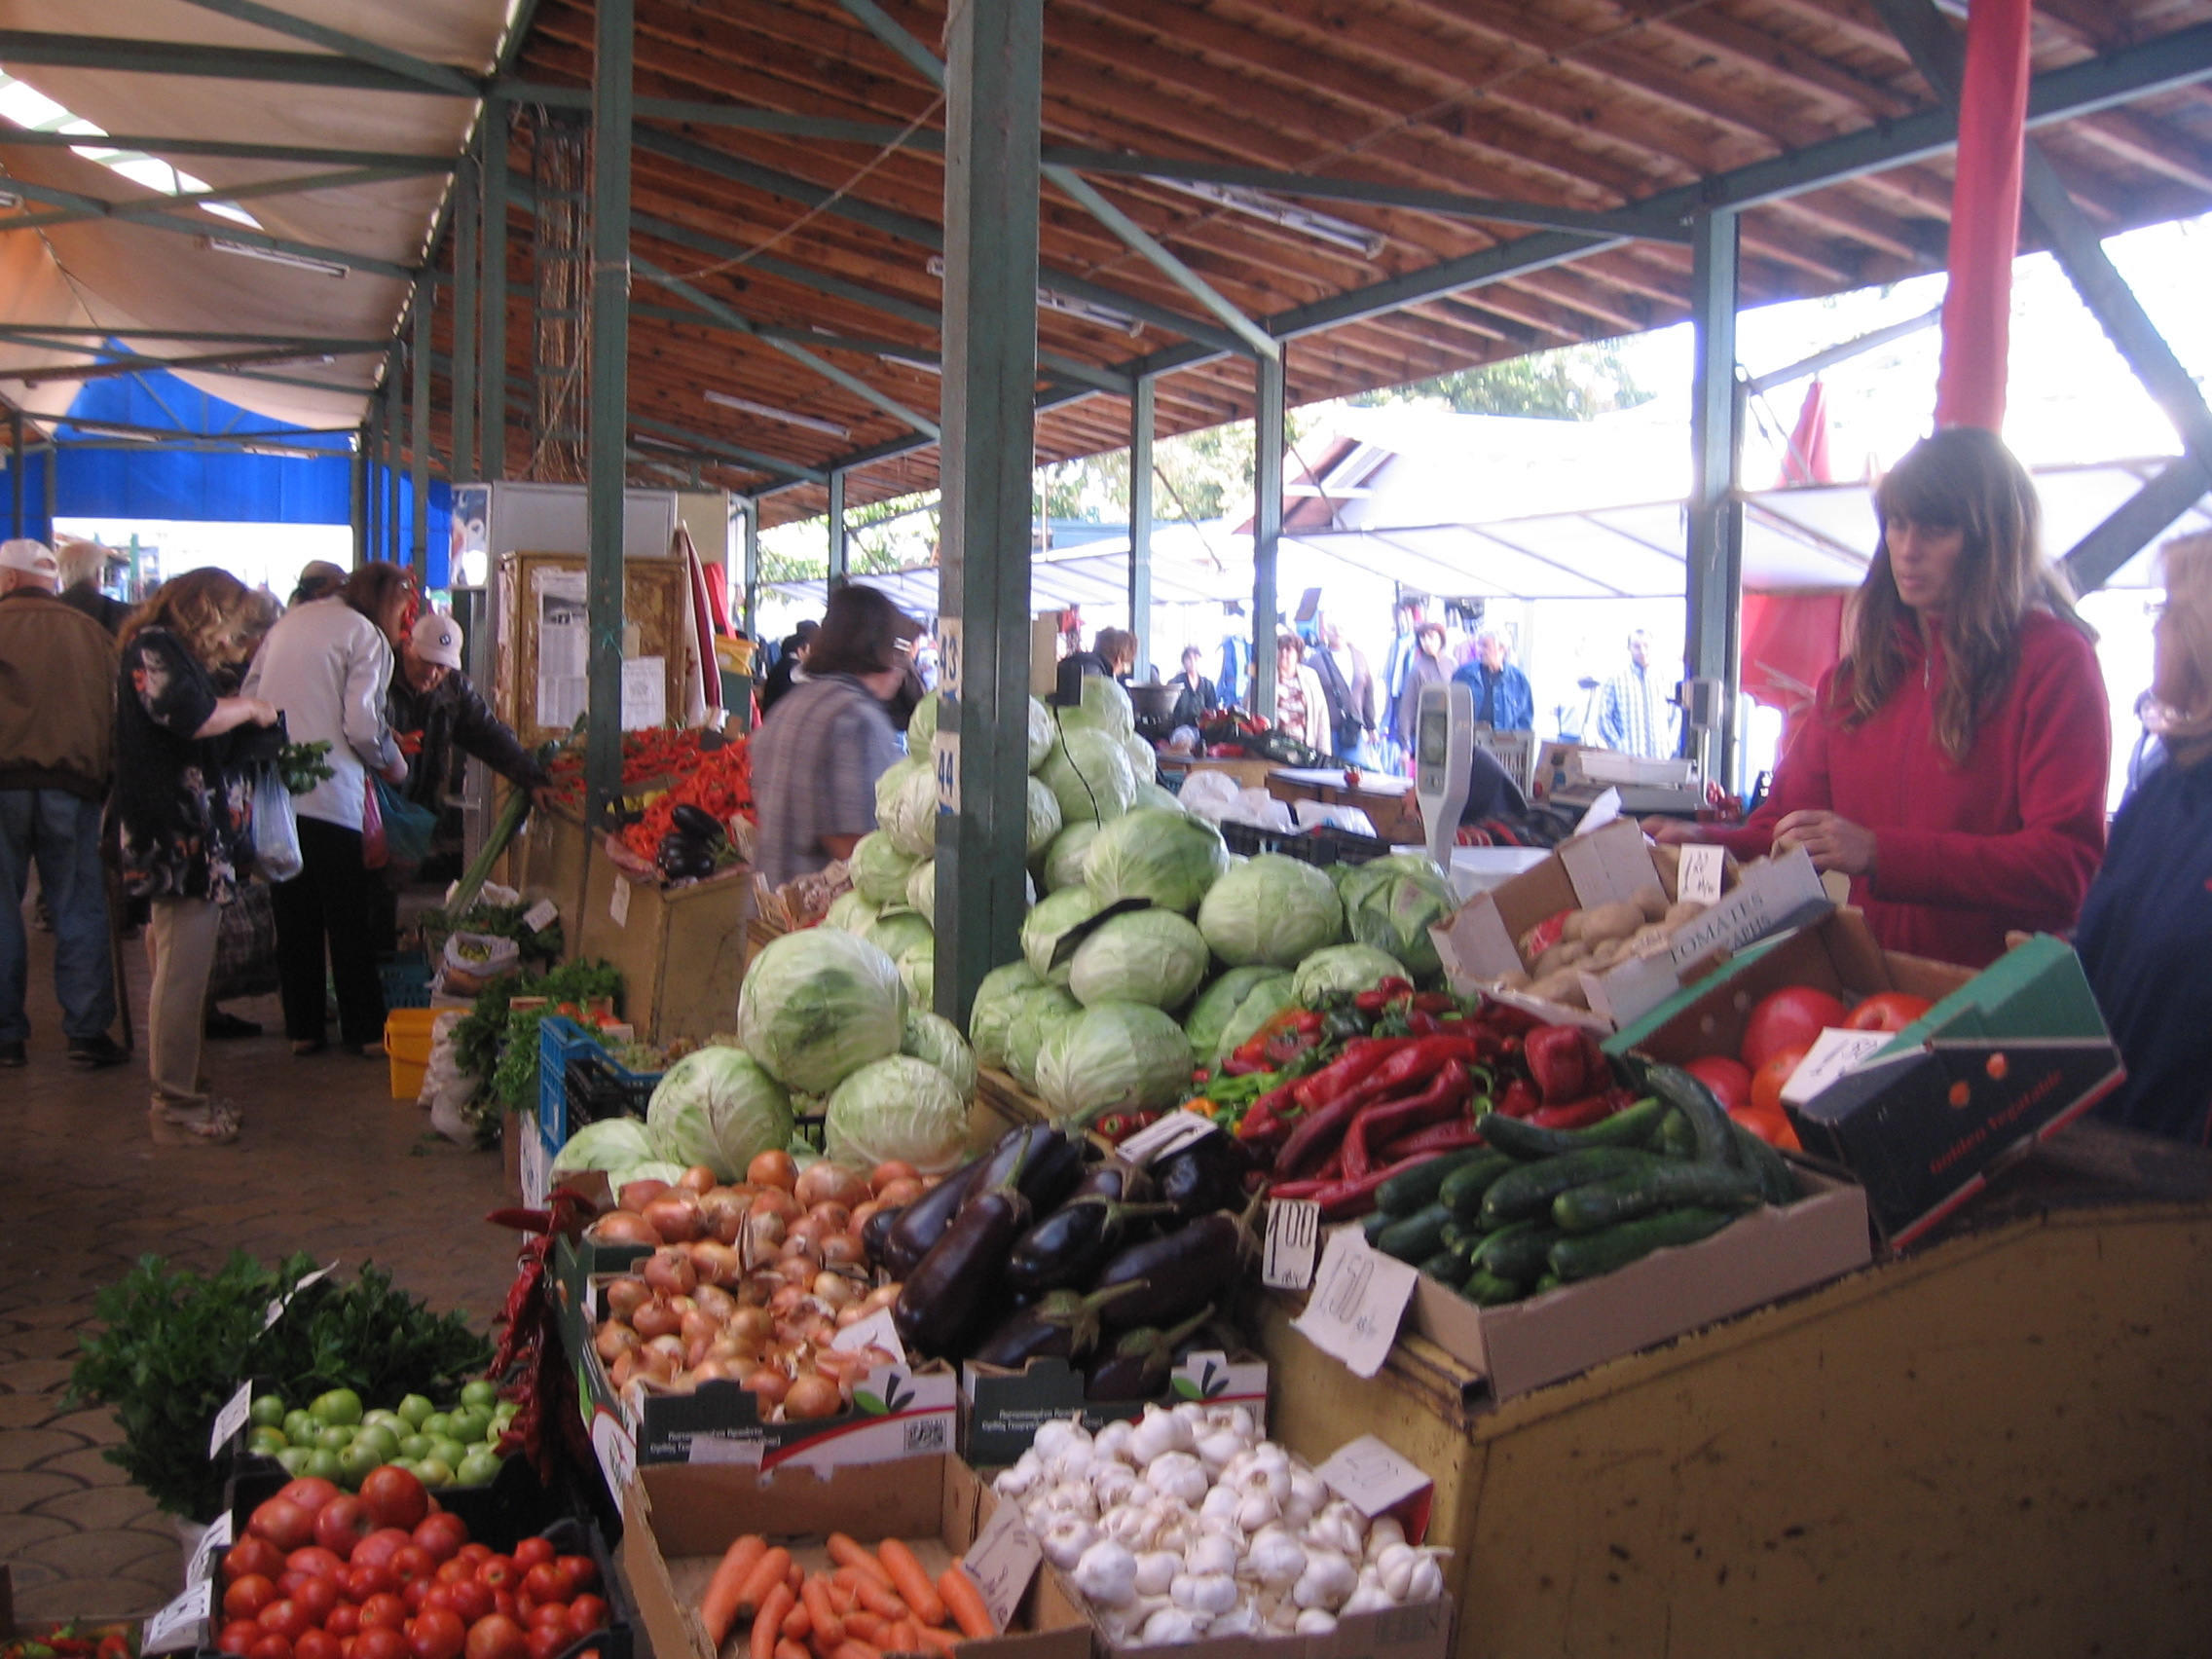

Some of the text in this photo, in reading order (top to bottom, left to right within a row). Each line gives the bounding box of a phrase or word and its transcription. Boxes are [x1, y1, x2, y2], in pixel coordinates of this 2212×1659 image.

[940, 635, 958, 682] 43
[938, 751, 954, 796] 44
[1668, 893, 1763, 964] TOMATES
